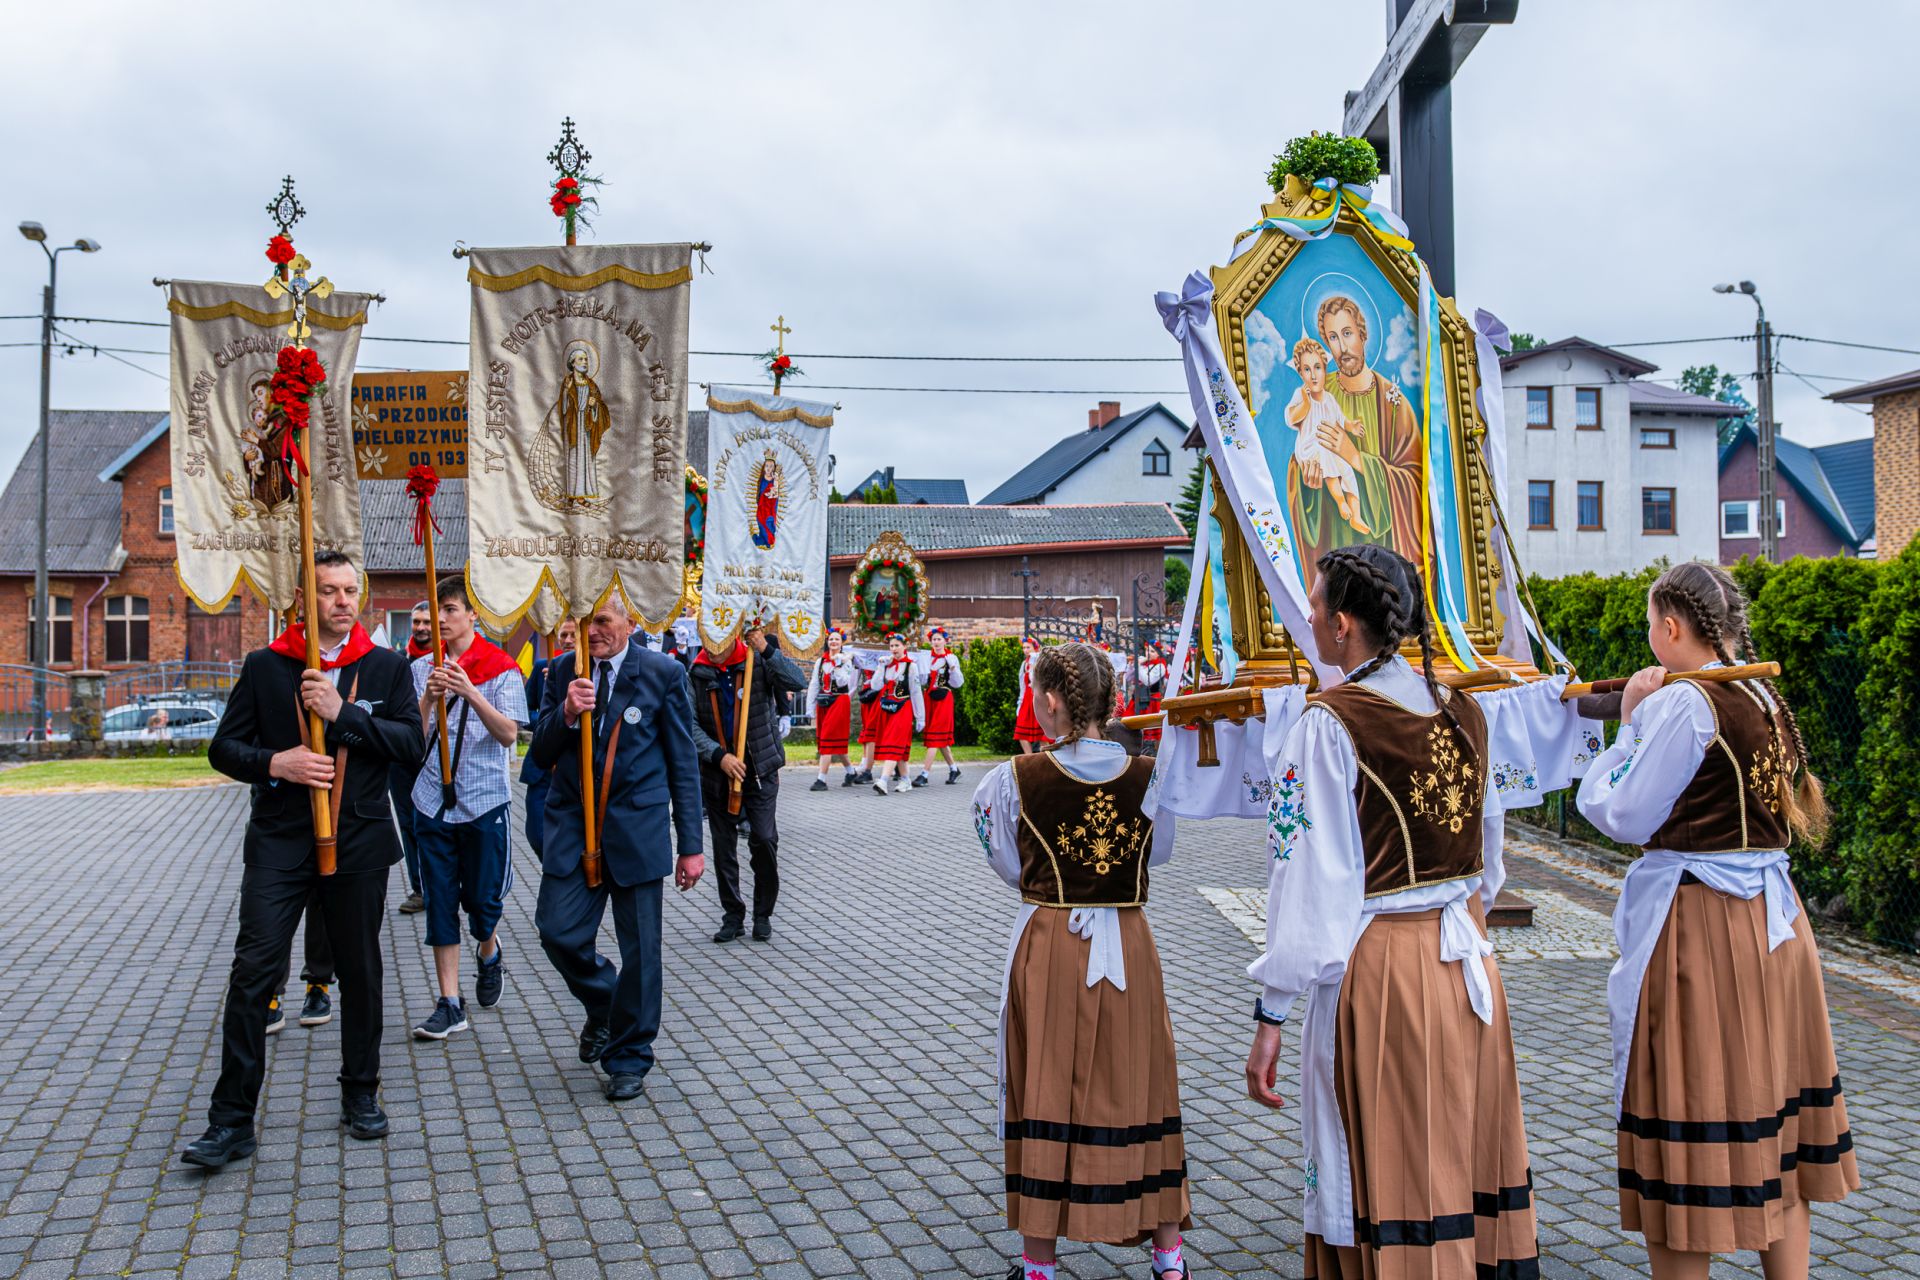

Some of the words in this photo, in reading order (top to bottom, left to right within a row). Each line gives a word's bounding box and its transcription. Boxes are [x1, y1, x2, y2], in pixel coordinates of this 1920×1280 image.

[625, 319, 652, 352] NA
[351, 385, 427, 402] PARAFIA
[648, 359, 672, 402] TEJ
[188, 370, 217, 439] ANTONI
[409, 452, 431, 466] OD
[437, 451, 466, 465] 193
[484, 449, 505, 474] TY
[652, 415, 673, 483] SKALE
[713, 448, 733, 491] MATKA
[735, 427, 771, 448] BOSKA
[192, 532, 279, 553] ZAGUBIONE
[485, 537, 572, 559] ZBUDUJĘ
[606, 538, 670, 563] KOŚCIÓŁ
